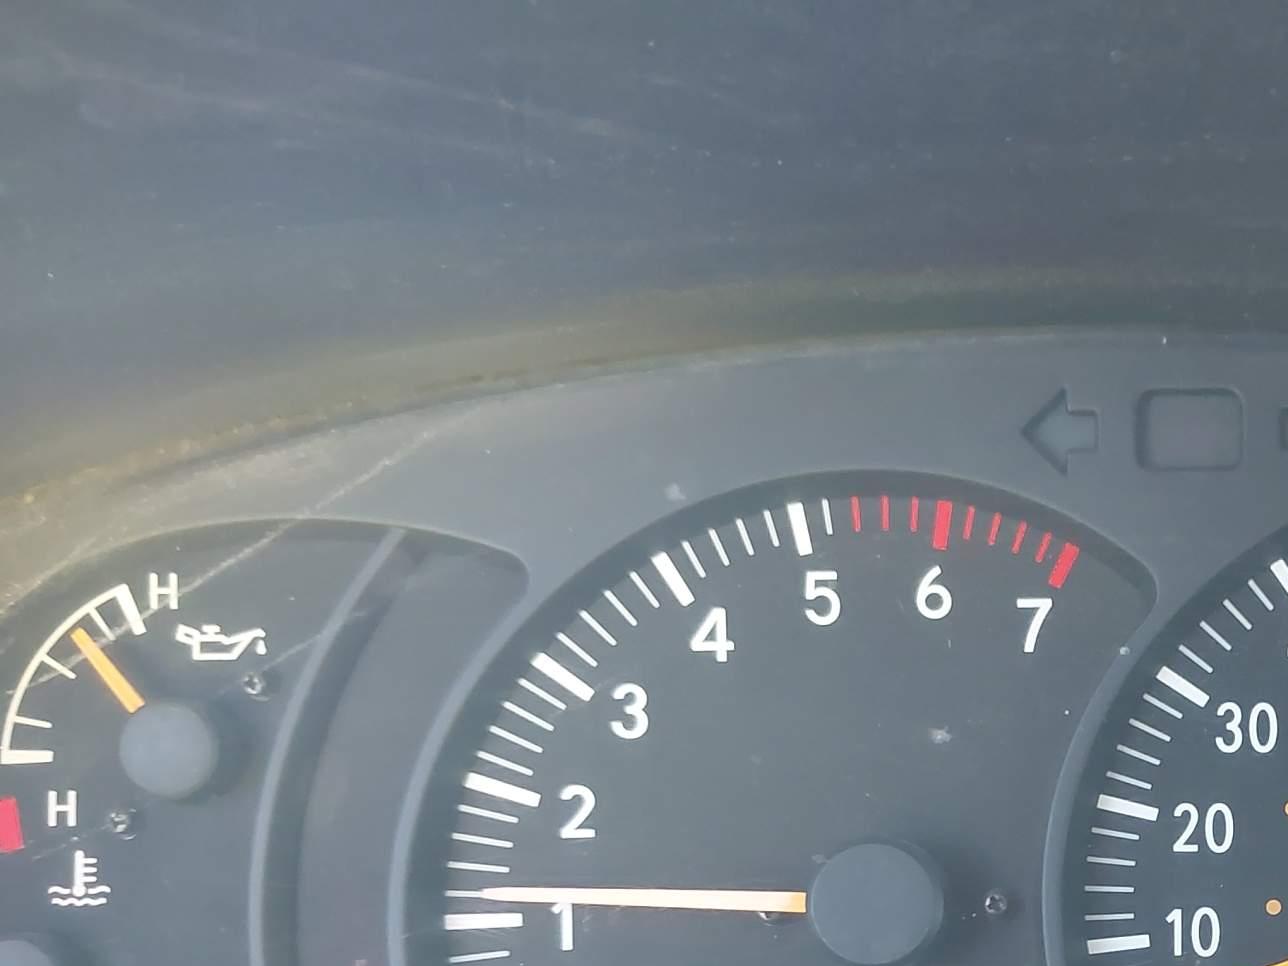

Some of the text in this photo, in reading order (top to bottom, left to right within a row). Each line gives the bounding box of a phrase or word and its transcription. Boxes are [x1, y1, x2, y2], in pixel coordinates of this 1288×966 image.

[144, 573, 179, 609] H
[805, 571, 840, 625] 5
[916, 566, 951, 619] 6
[690, 607, 734, 662] 4
[1017, 598, 1052, 652] 7
[611, 683, 648, 739] 3
[1216, 702, 1277, 753] 30
[48, 791, 76, 826] H
[560, 785, 595, 838] 2
[1173, 803, 1233, 853] 20
[551, 903, 573, 950] 1
[1166, 907, 1220, 957] 10
